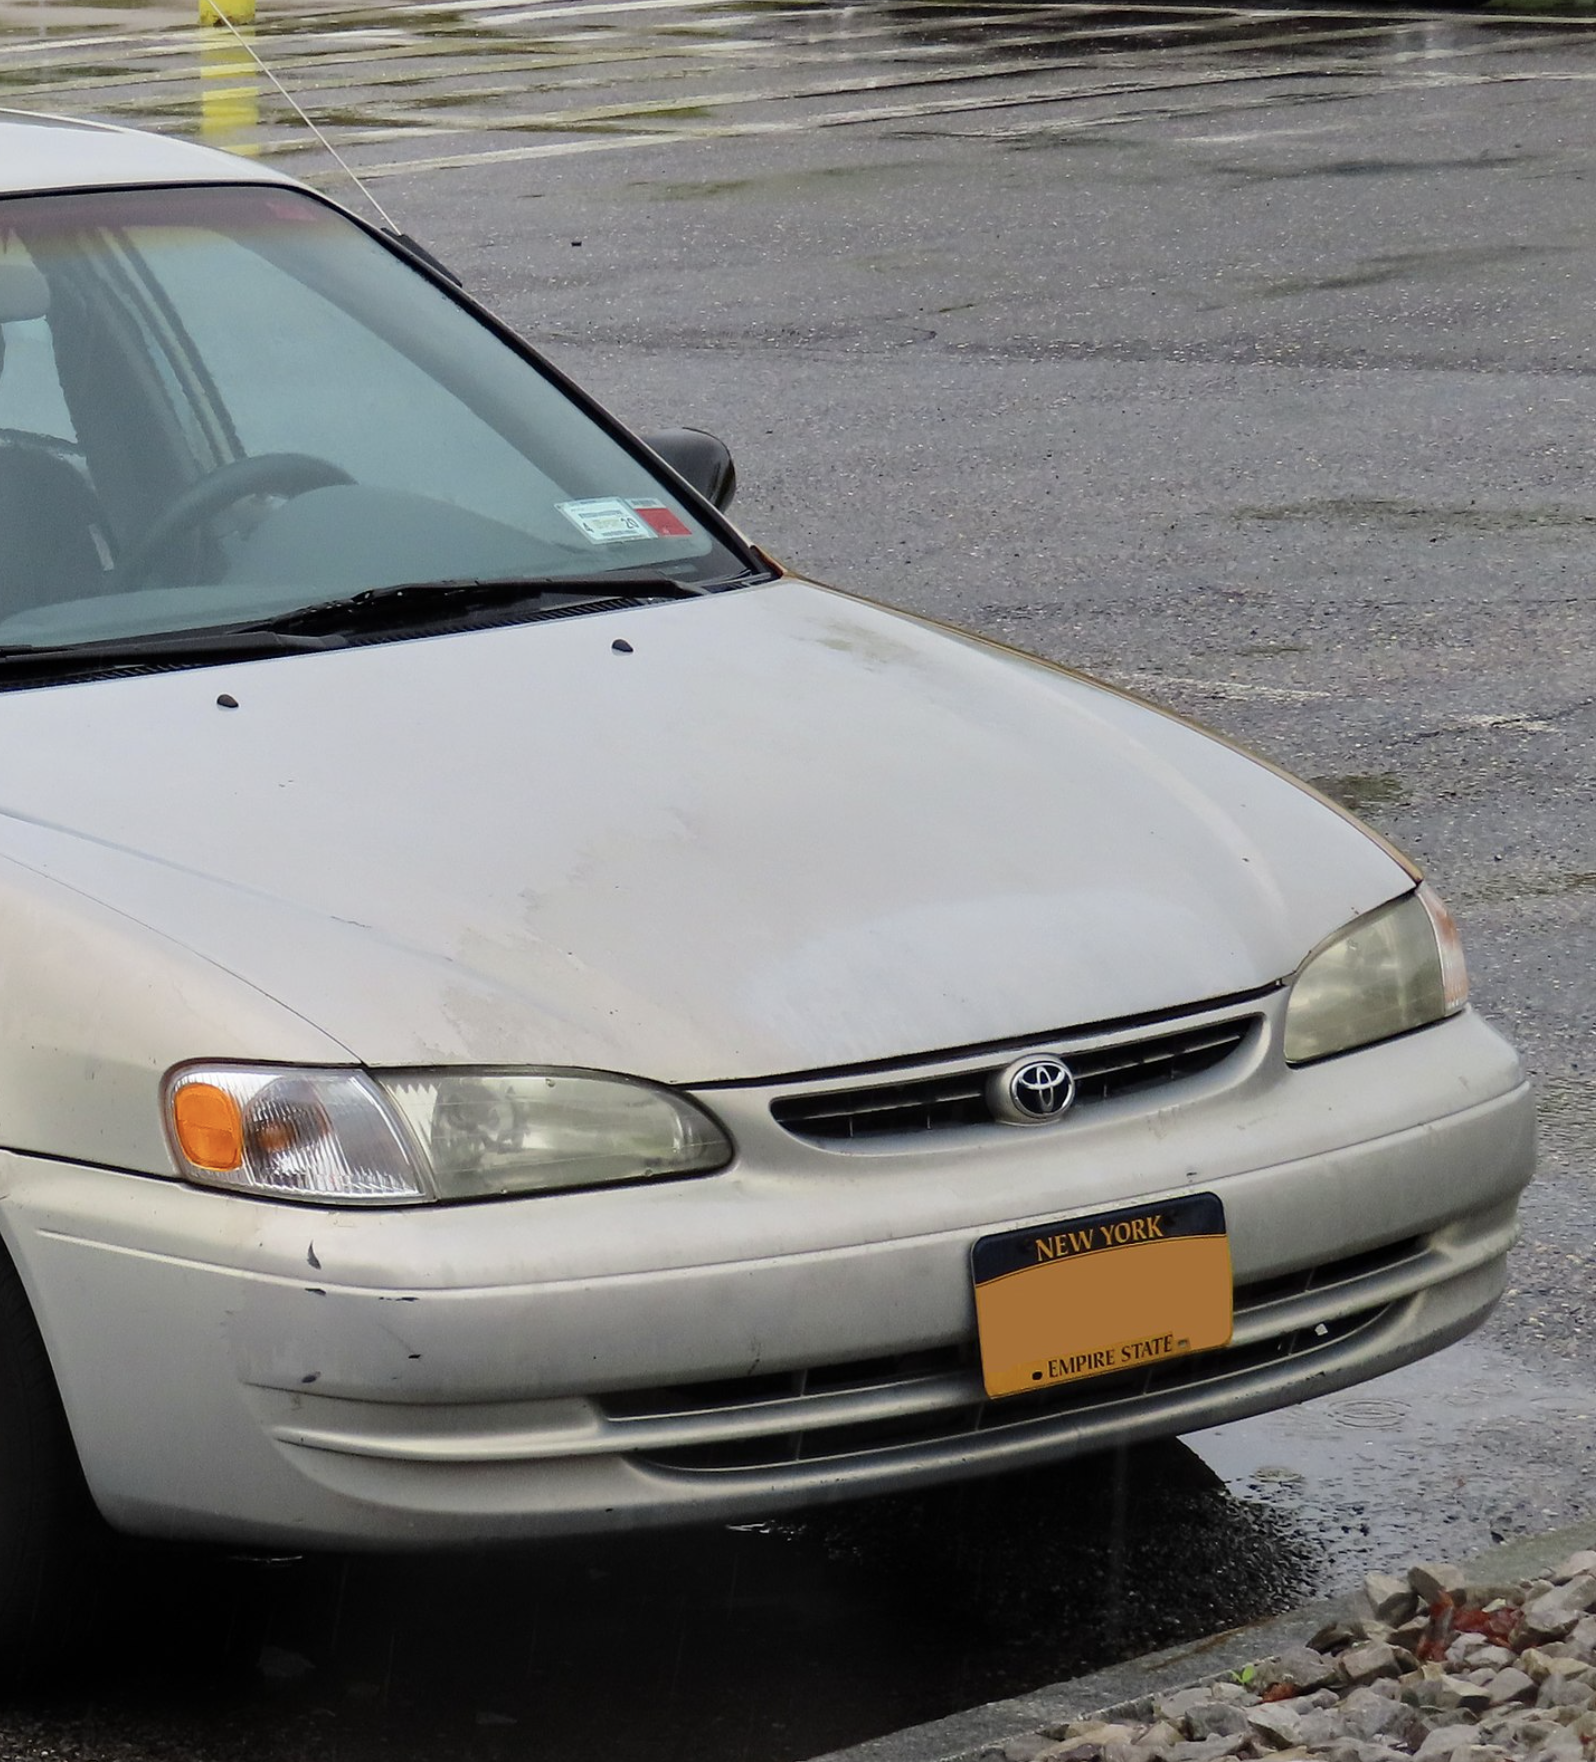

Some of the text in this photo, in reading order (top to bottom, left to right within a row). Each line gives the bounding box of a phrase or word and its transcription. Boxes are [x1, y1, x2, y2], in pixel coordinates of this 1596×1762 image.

[1036, 1215, 1164, 1261] NEW YORK
[1048, 1334, 1173, 1378] EMPIRE STATE
